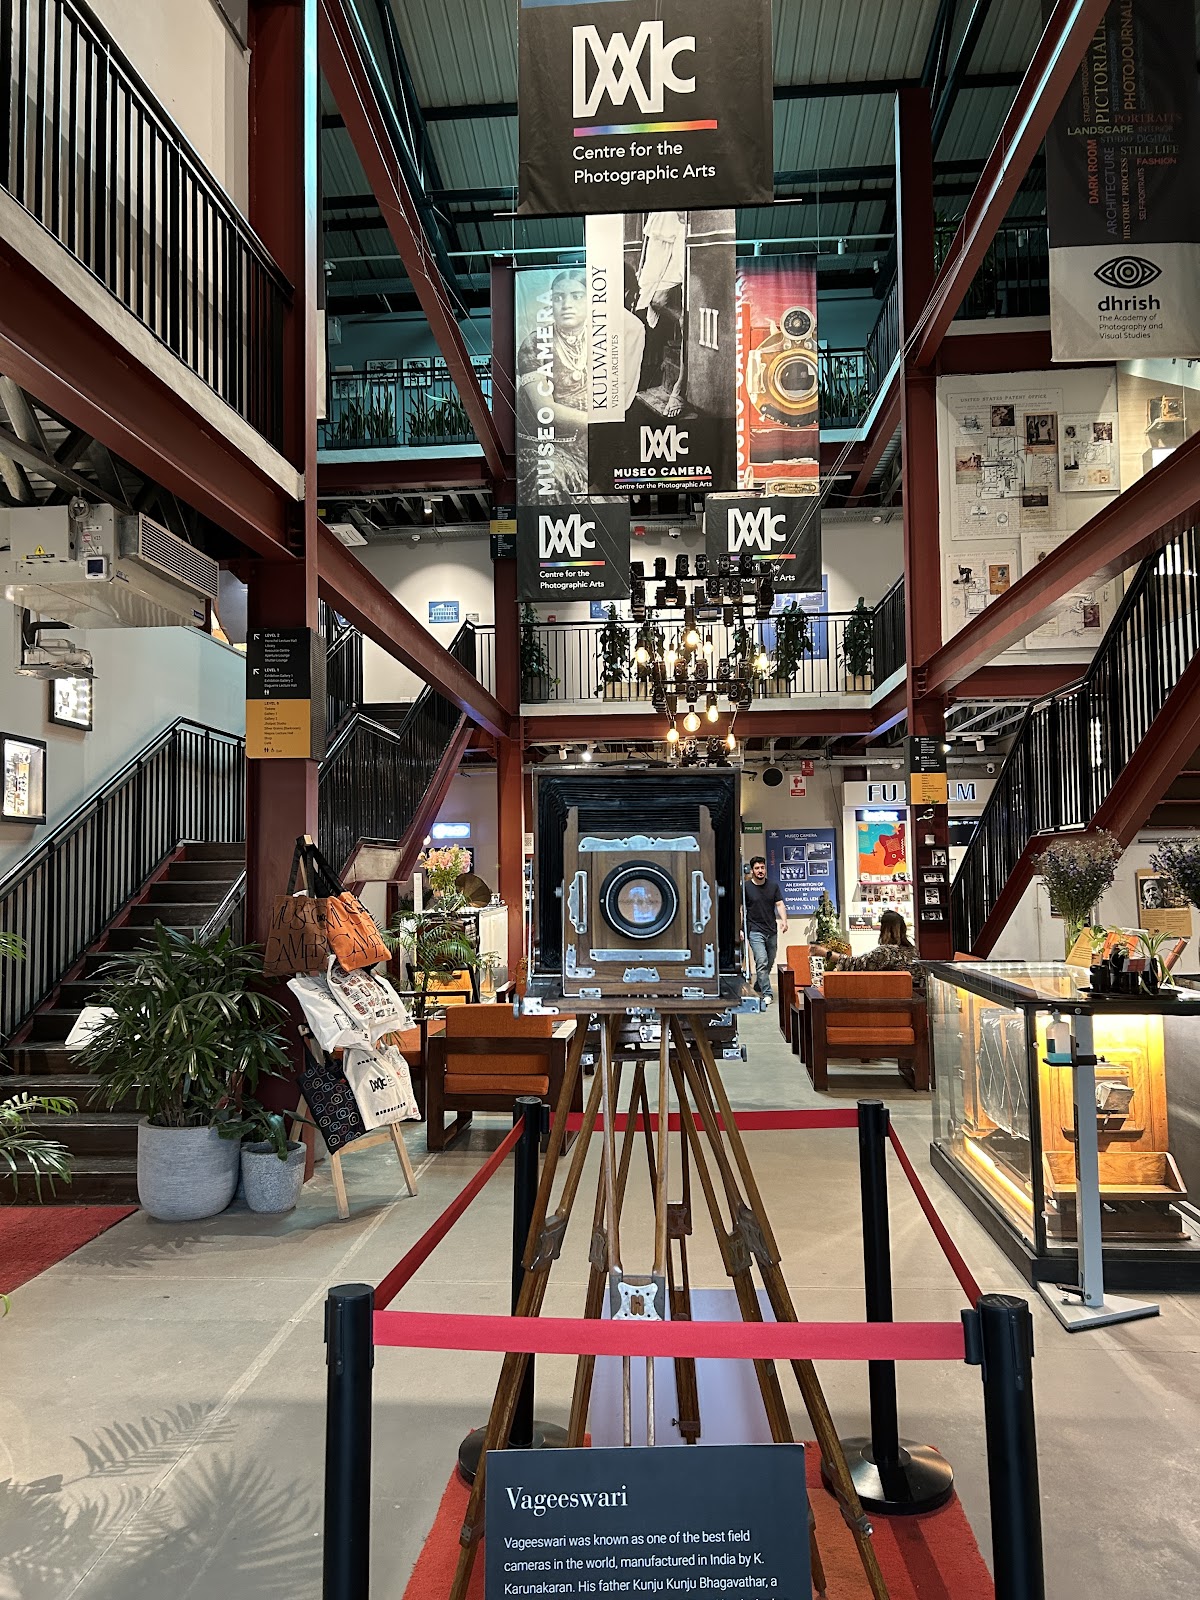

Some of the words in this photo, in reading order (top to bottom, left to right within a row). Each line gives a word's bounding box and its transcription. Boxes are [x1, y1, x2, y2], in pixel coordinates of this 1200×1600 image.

[1083, 95, 1091, 123] STAGED
[1067, 125, 1134, 136] LANDSCAPE
[1100, 135, 1133, 144] STUDIO
[1136, 134, 1173, 143] DIGITAL
[572, 145, 626, 161] Centre
[629, 141, 653, 157] for
[656, 140, 683, 156] the
[1087, 138, 1098, 172] ROOM
[1120, 145, 1152, 155] STILL
[1155, 144, 1179, 154] LIFE
[1136, 157, 1177, 165] FASHION
[574, 164, 680, 186] Photographic
[683, 163, 717, 179] Arts
[1120, 157, 1130, 196] PROCESS
[1088, 173, 1099, 204] DARK
[1104, 147, 1118, 235] ARCHITECTURE
[1121, 197, 1131, 240] HISTORIC
[591, 265, 607, 306] ROY
[1098, 294, 1161, 311] dhrish
[1099, 323, 1147, 332] Photography
[1114, 314, 1147, 322] Academy
[536, 290, 554, 398] CAMERA
[592, 310, 608, 411] KULWANT
[537, 406, 555, 496] MUSEO
[614, 467, 657, 478] MUSEO
[660, 465, 713, 476] CAMERA
[657, 481, 699, 490] Photographic
[699, 480, 712, 488] Arts
[539, 570, 564, 578] Centre
[565, 569, 577, 578] for
[577, 569, 590, 577] the
[779, 573, 796, 582] Arts
[540, 580, 588, 590] Photographic
[589, 579, 605, 588] Arts
[505, 1485, 629, 1516] Vageeswari
[504, 1534, 567, 1551] Vageeswari
[569, 1536, 591, 1547] was
[594, 1532, 629, 1546] known
[631, 1535, 645, 1545] as
[647, 1534, 667, 1545] one
[669, 1531, 682, 1544] of
[683, 1530, 700, 1544] the
[702, 1530, 726, 1543] best
[727, 1529, 751, 1542] field
[504, 1559, 552, 1573] cameras
[554, 1558, 564, 1570] in
[566, 1557, 583, 1570] the
[585, 1556, 619, 1571] world,
[620, 1555, 697, 1569] manufactured
[698, 1554, 708, 1566] in
[710, 1553, 737, 1567] India
[739, 1552, 753, 1568] by
[754, 1552, 765, 1565] K.
[505, 1580, 576, 1596] Karunakaran.
[578, 1580, 597, 1593] His
[598, 1578, 632, 1592] father
[633, 1578, 665, 1594] Kunju
[666, 1577, 698, 1593] Kunju
[700, 1575, 769, 1592] Bhagavathar,
[771, 1577, 779, 1588] a
